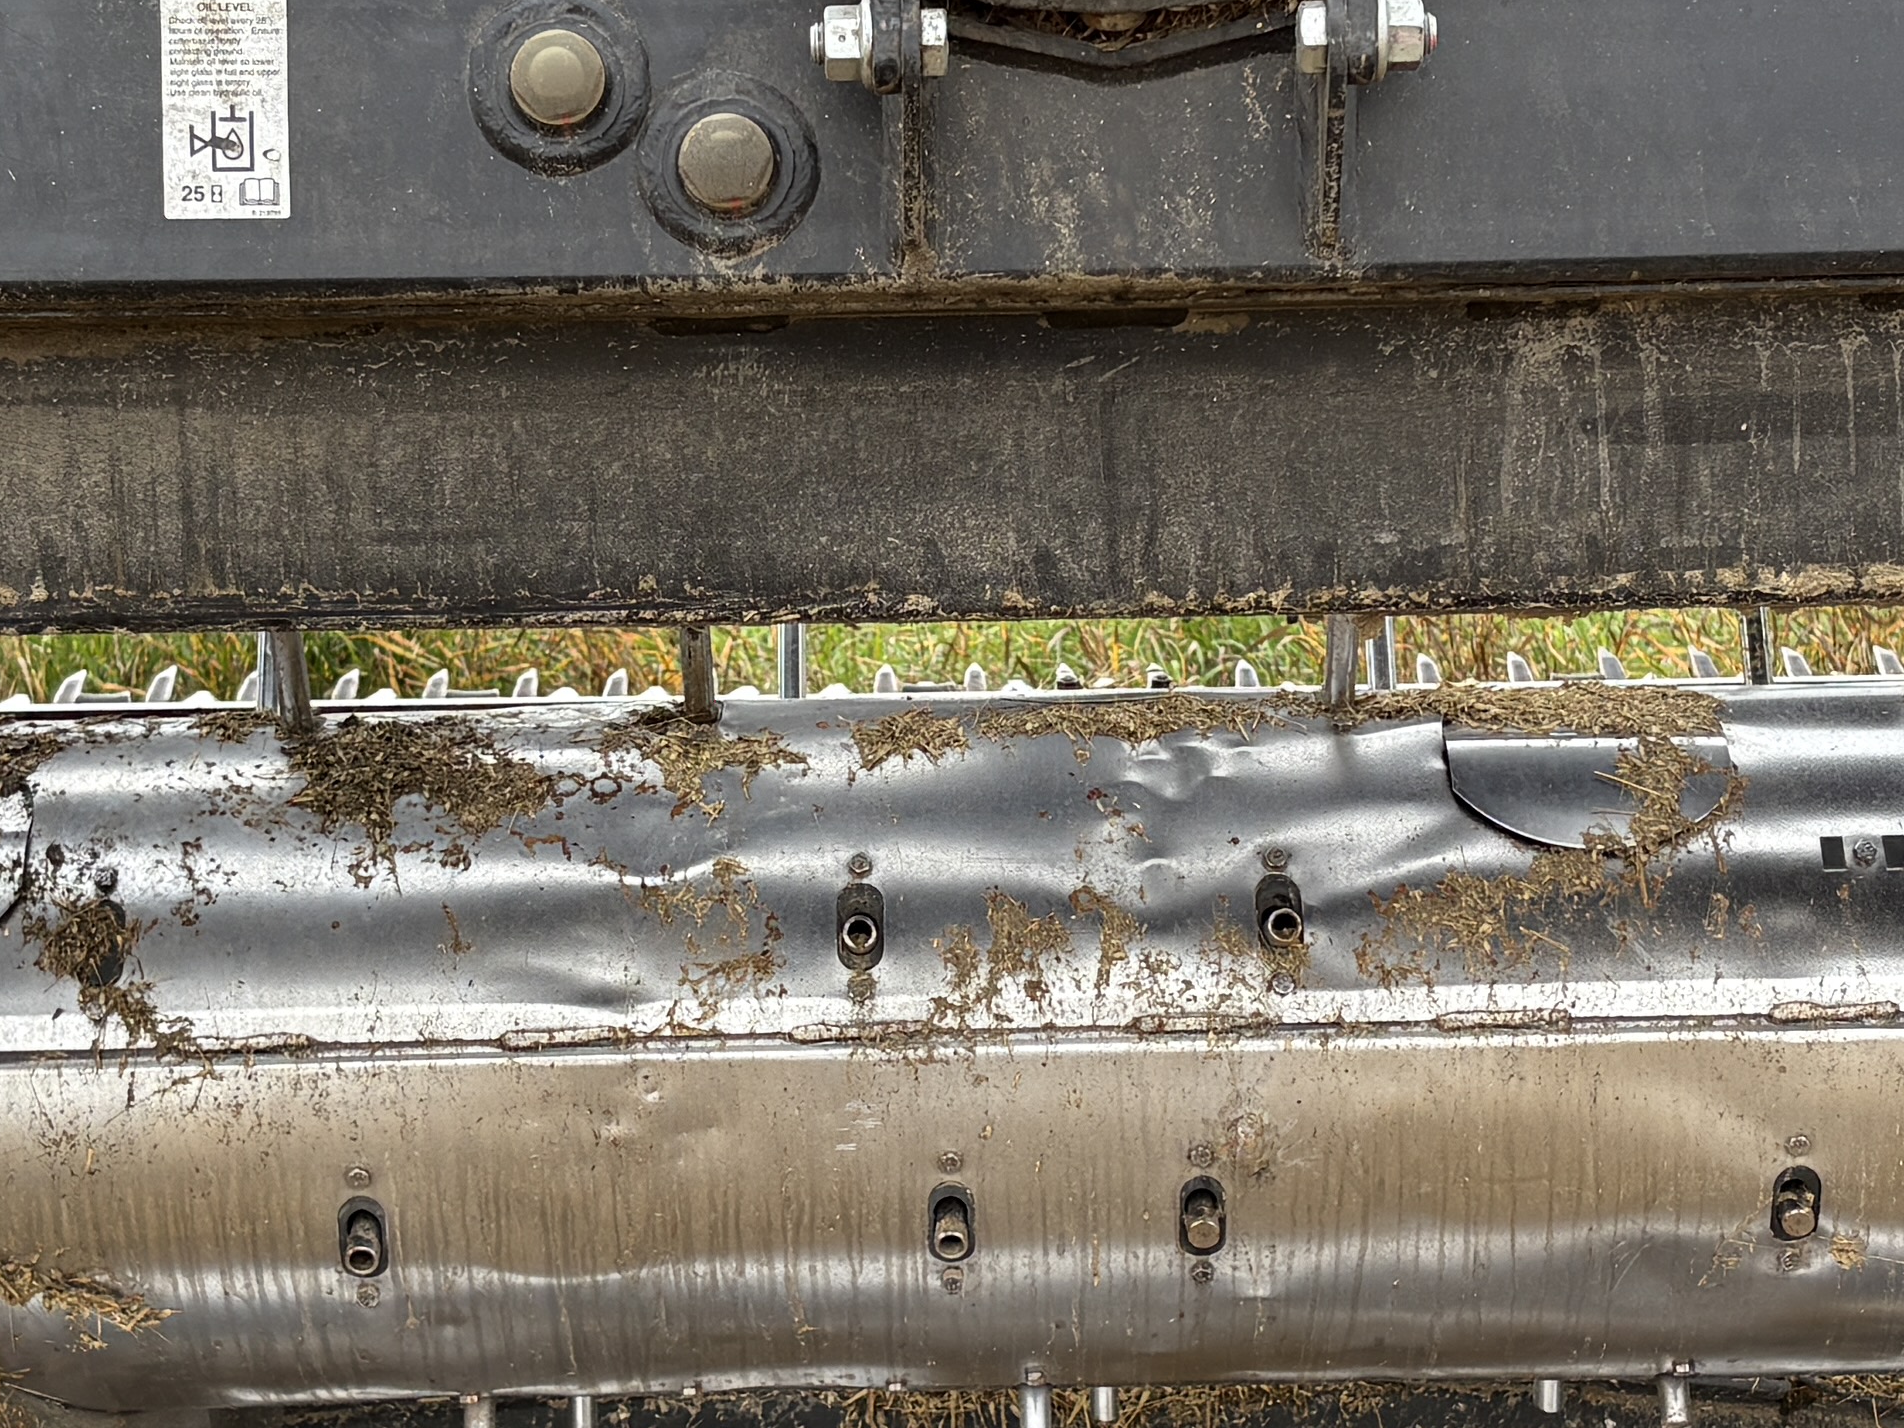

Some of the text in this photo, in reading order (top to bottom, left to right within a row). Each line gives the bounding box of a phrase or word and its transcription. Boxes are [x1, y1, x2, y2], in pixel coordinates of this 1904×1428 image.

[197, 2, 254, 13] OIL LEVEL
[181, 185, 205, 202] 25
